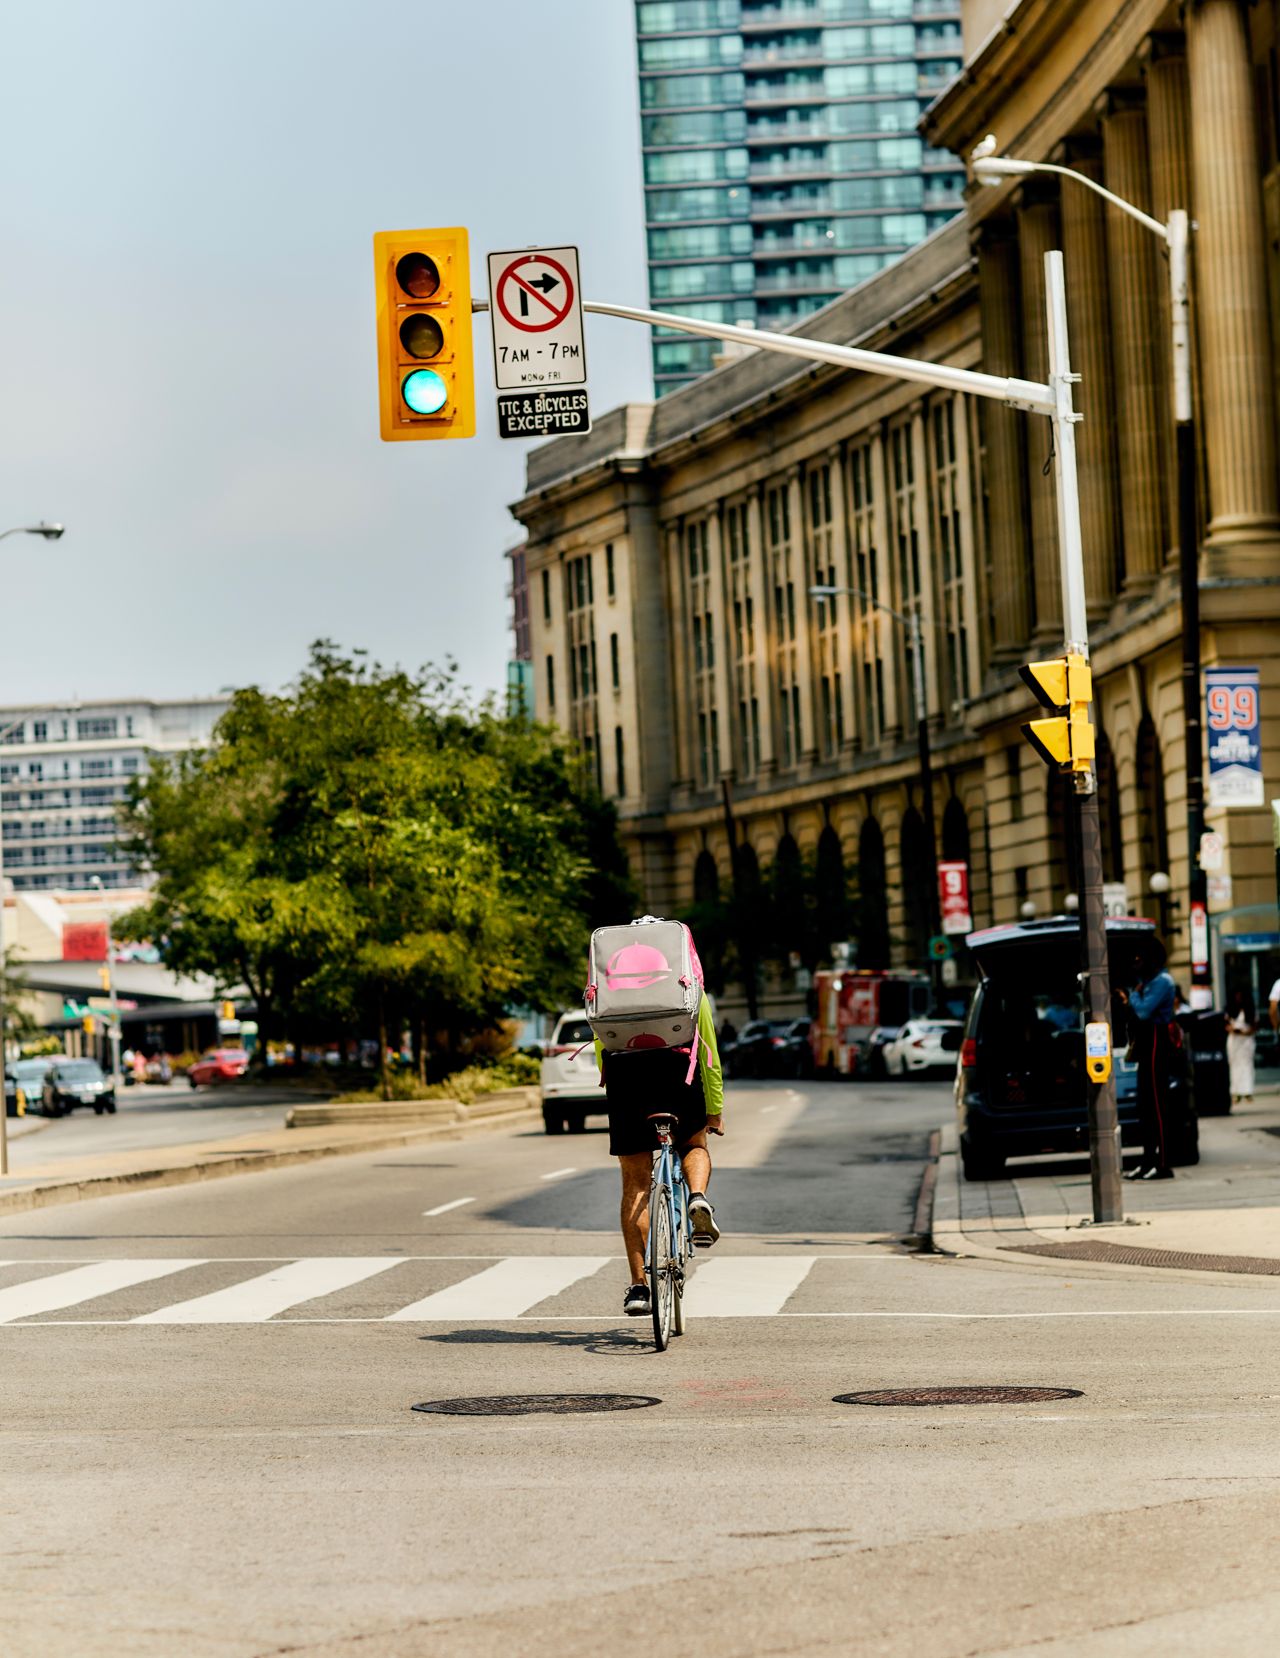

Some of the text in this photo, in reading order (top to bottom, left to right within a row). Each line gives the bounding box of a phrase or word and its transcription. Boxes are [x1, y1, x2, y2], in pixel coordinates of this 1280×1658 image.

[499, 395, 587, 416] TTC & BICYCLES
[508, 412, 581, 431] EXCEPTED
[1208, 686, 1258, 731] 99
[945, 871, 962, 895] 9
